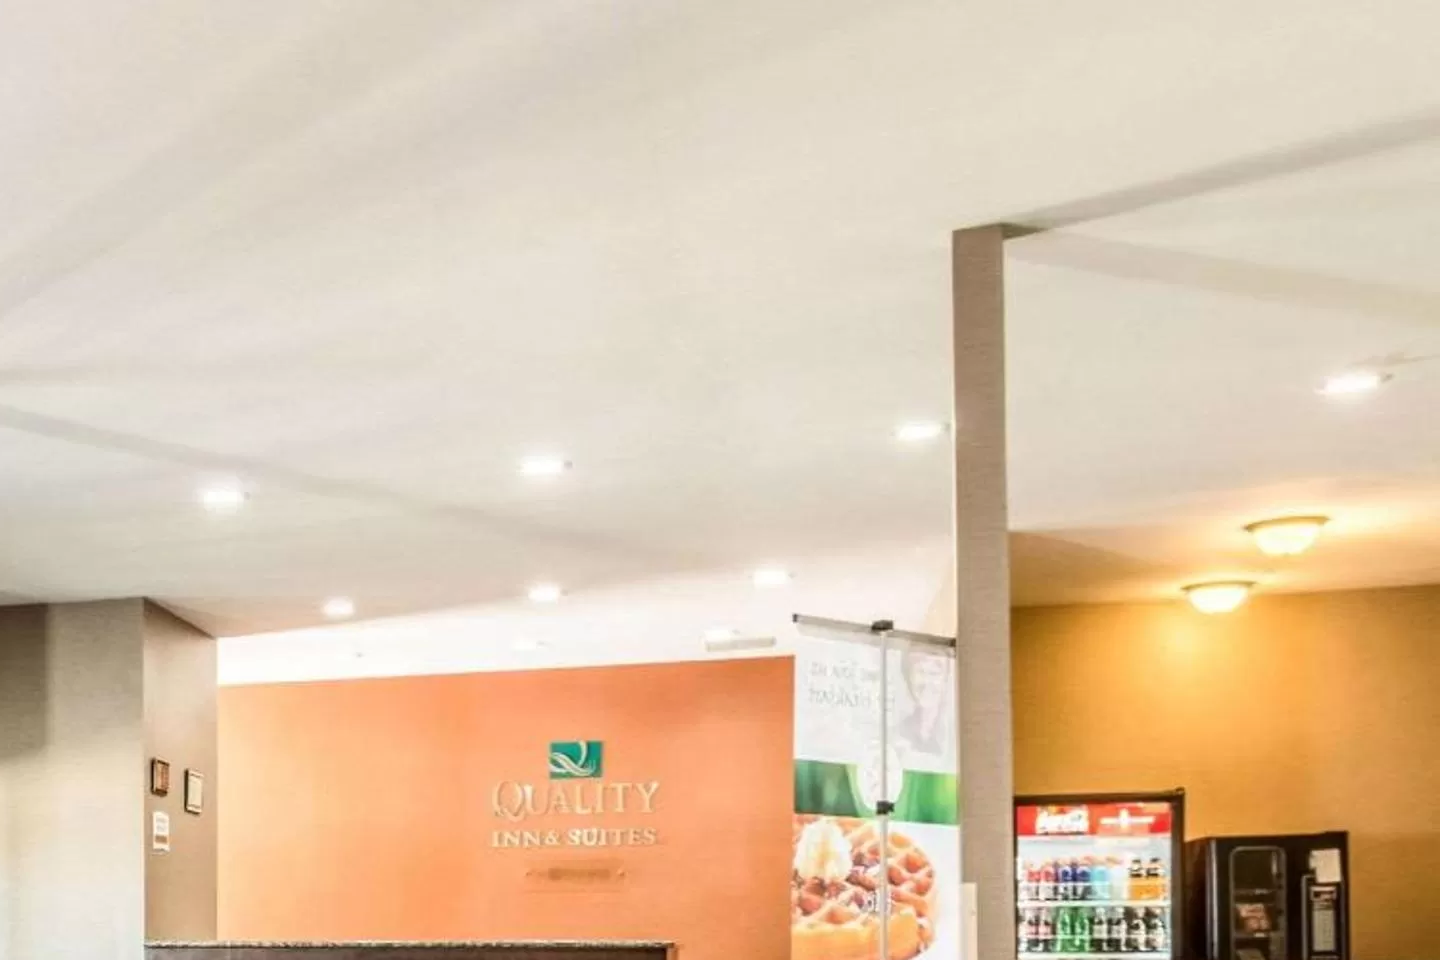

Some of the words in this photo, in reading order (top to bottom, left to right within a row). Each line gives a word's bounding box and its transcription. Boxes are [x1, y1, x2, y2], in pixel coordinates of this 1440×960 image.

[491, 780, 659, 822] QUALITY
[491, 829, 540, 848] INN
[568, 827, 657, 846] SUITES
